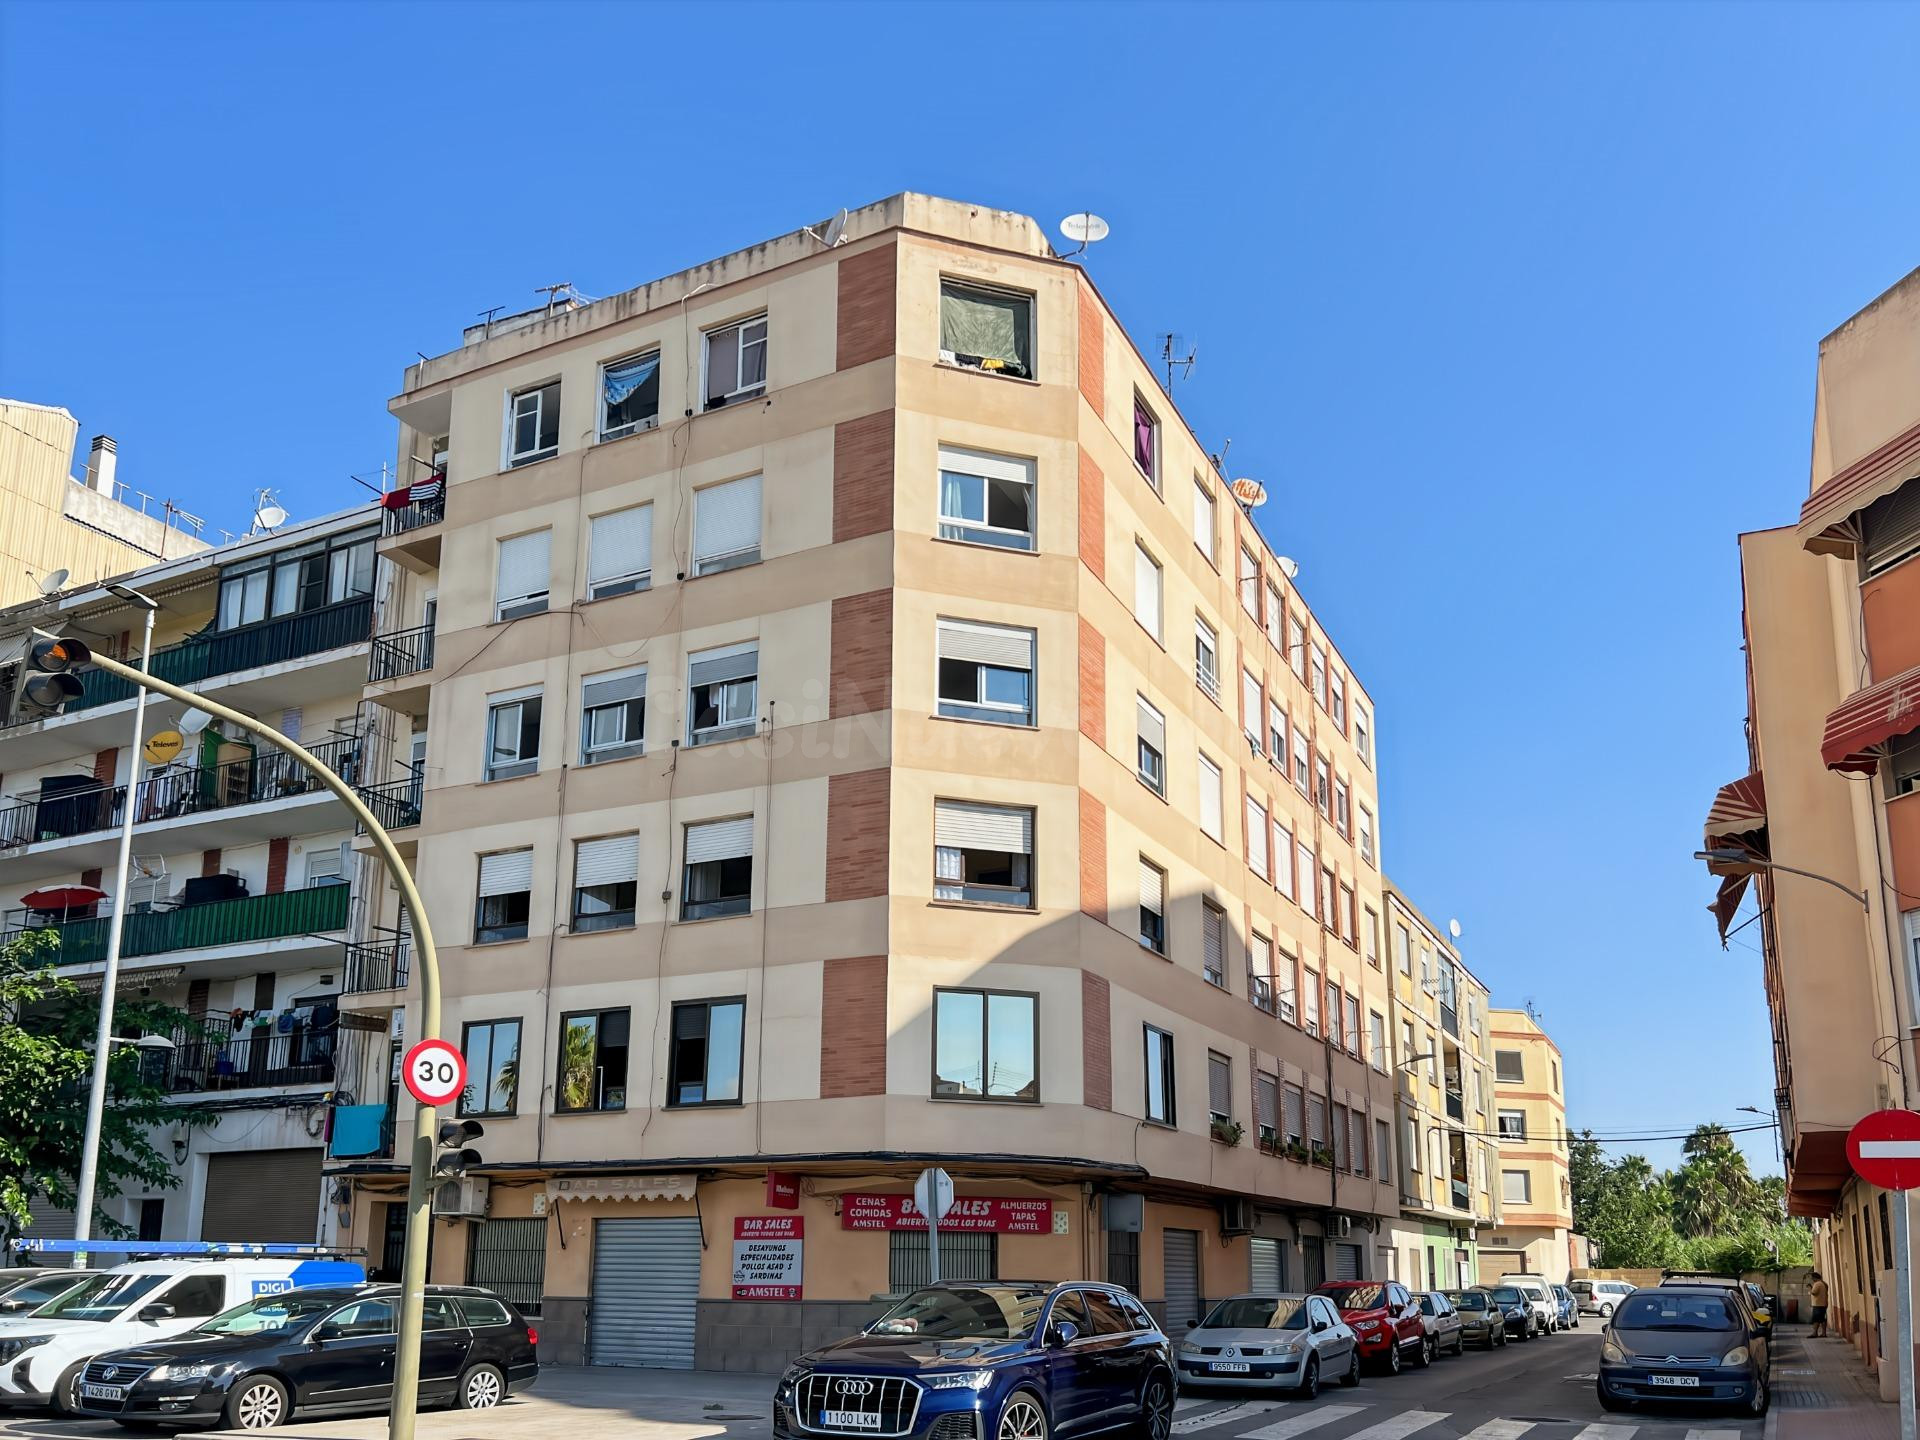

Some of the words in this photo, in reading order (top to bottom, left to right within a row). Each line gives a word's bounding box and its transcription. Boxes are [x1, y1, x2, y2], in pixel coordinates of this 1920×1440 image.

[419, 1060, 454, 1084] 30
[856, 1197, 887, 1207] CENAS
[1000, 1201, 1047, 1211] ALMUERZOS
[849, 1208, 892, 1218] COMIDAS
[950, 1200, 992, 1216] ALES
[1011, 1212, 1037, 1221] TAPAS
[743, 1219, 763, 1230] BAR
[764, 1219, 793, 1230] SALES
[852, 1220, 886, 1228] AMSTEL
[937, 1218, 959, 1227] ODOS
[960, 1219, 976, 1227] LOS
[977, 1219, 997, 1228] DIAS
[1008, 1222, 1040, 1231] AMSTEL
[748, 1244, 787, 1252] DESAYUNOS
[740, 1253, 795, 1261] ESPECIALIDADES
[741, 1263, 766, 1271] POLLOS
[749, 1272, 784, 1280] SARDINAS
[258, 1282, 285, 1293] DIGI
[748, 1287, 785, 1297] AMSTEL
[1213, 1363, 1231, 1371] 9550
[1233, 1363, 1247, 1371] FFB
[1654, 1376, 1675, 1385] 3948
[104, 1388, 120, 1399] GVX
[828, 1412, 854, 1424] 1100
[856, 1413, 878, 1426] LKM
